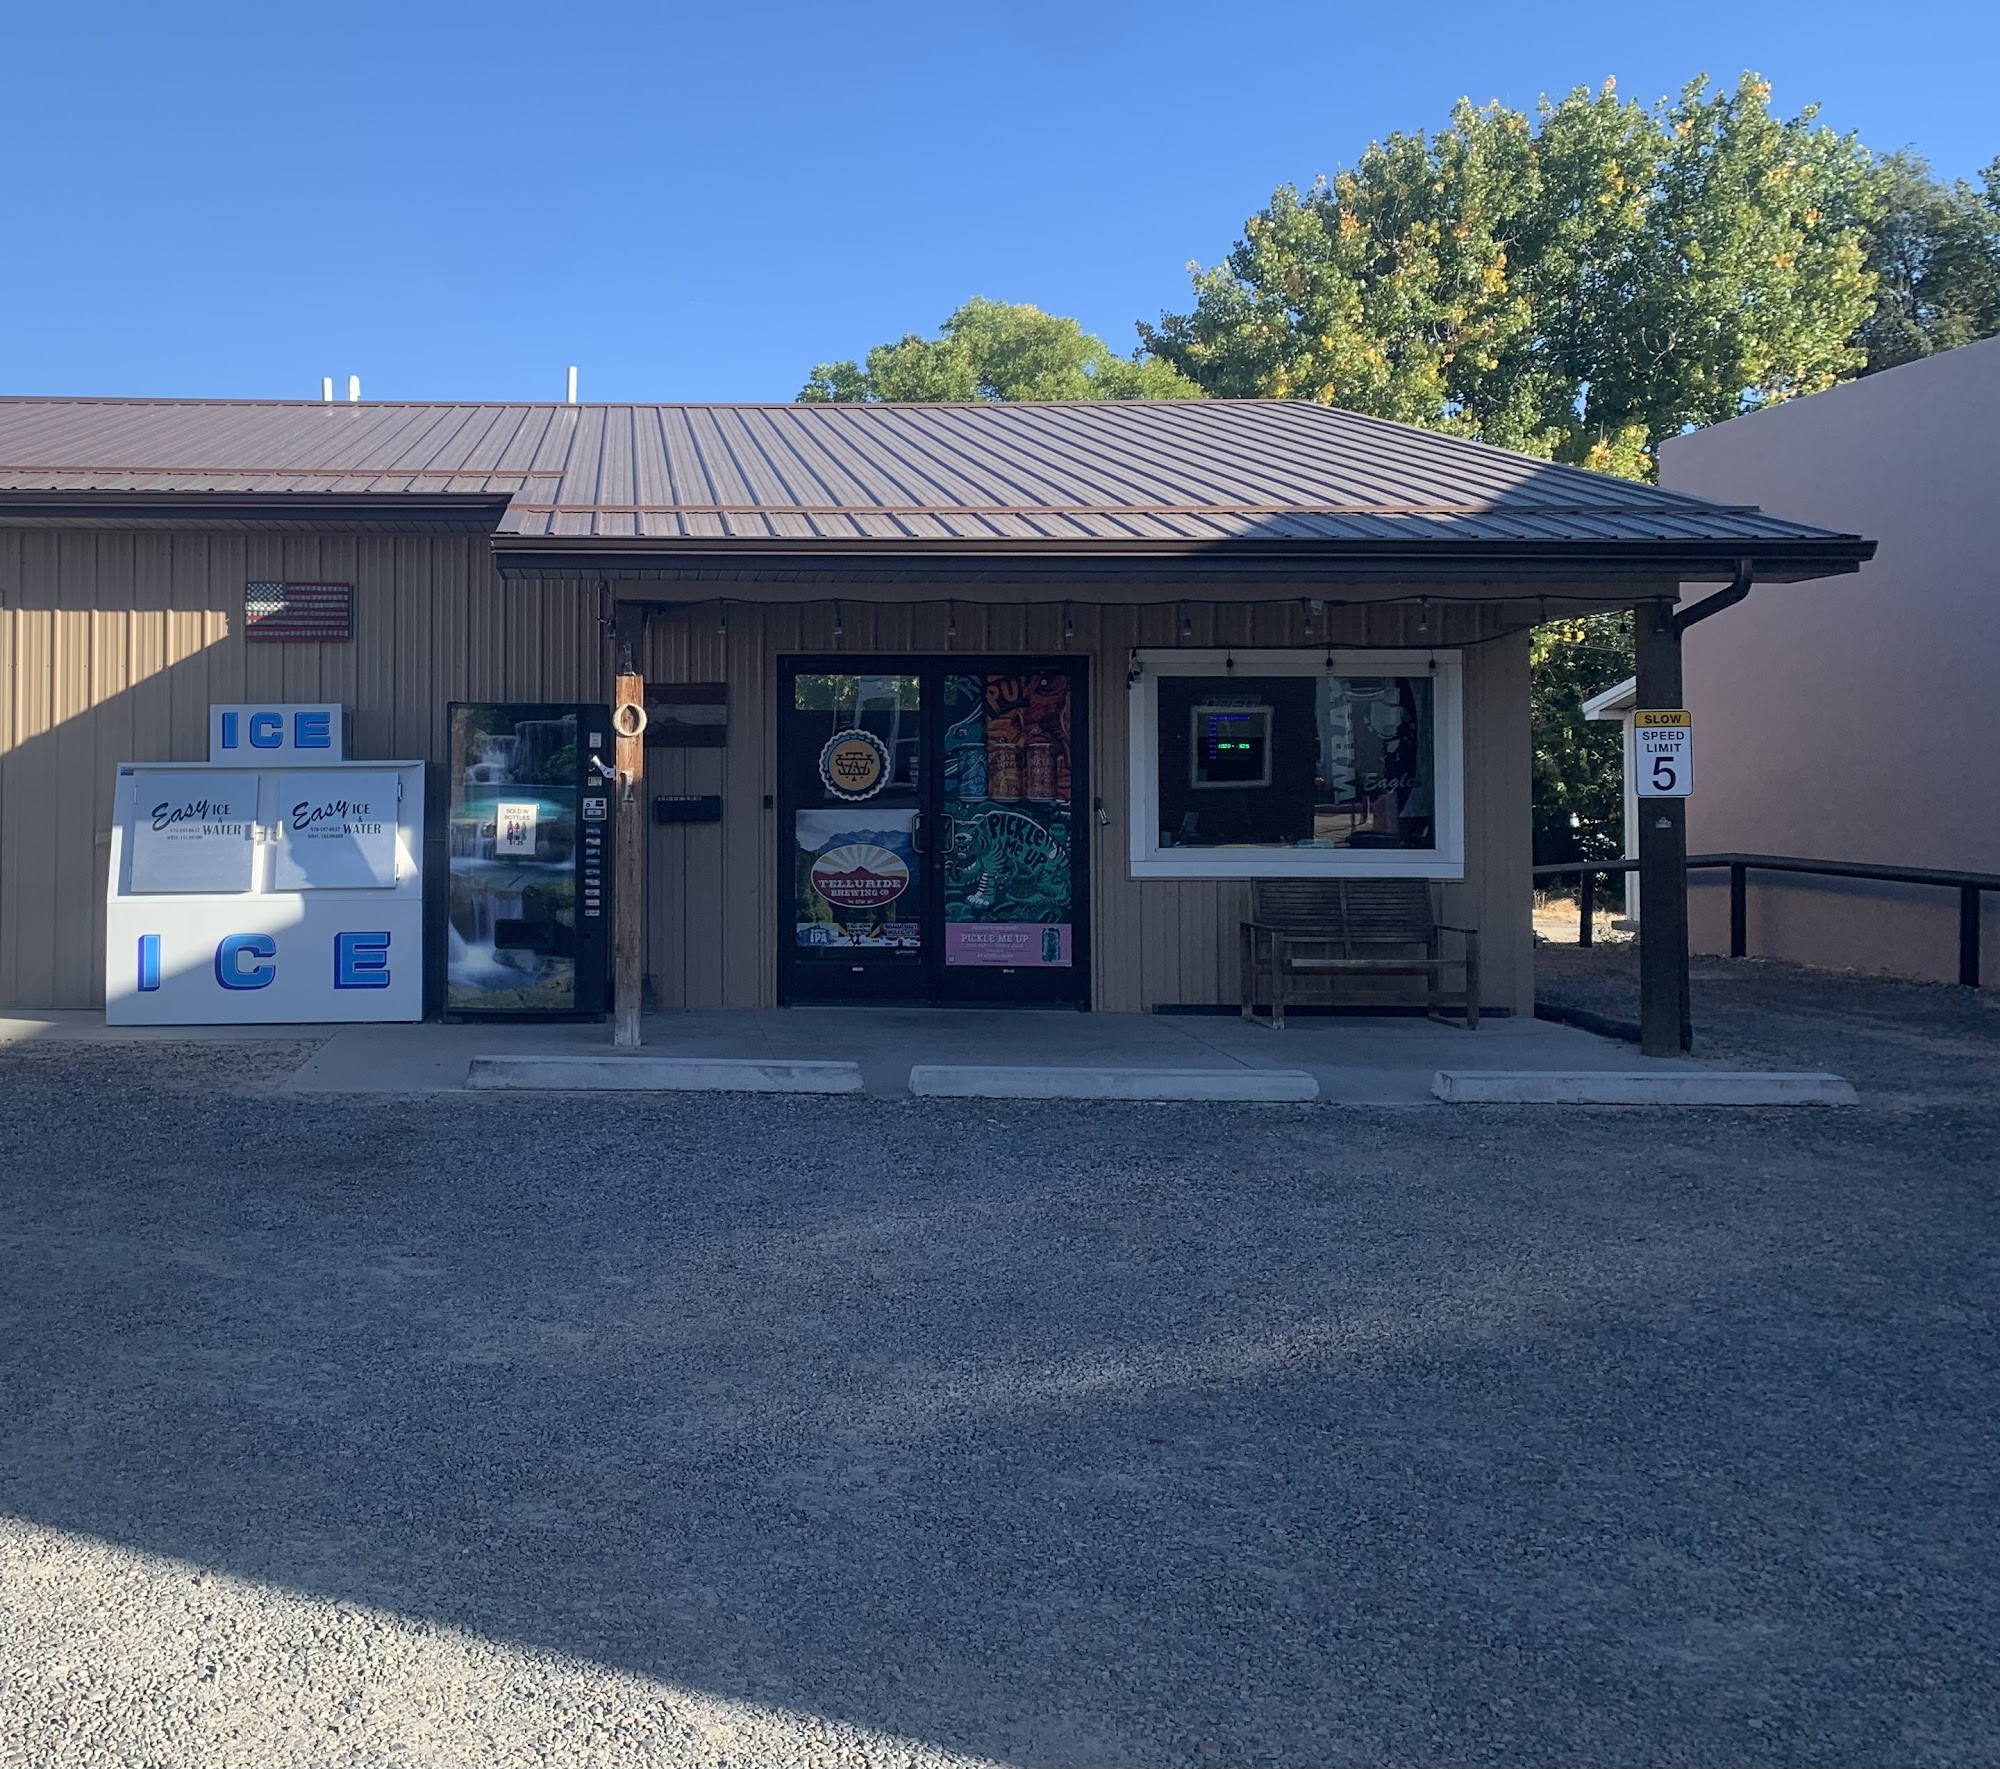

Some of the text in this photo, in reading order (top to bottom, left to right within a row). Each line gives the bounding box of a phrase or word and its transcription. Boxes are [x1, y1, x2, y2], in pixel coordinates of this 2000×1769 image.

[1644, 714, 1682, 724] SLOW
[222, 712, 331, 749] ICE
[1642, 731, 1685, 741] SPEED
[1646, 743, 1682, 753] LIMIT
[1652, 756, 1677, 791] 5
[151, 799, 231, 832] Easy ICE
[217, 816, 223, 824] &
[292, 799, 371, 831] Easy ICE
[358, 815, 363, 823] &
[203, 824, 241, 836] WATER
[343, 823, 381, 834] WATER
[1023, 847, 1048, 871] UP
[818, 879, 902, 889] TELLURIDE
[830, 889, 878, 897] BREWING
[810, 929, 827, 943] IPA
[961, 934, 1029, 943] PICKLE ME UP
[138, 931, 391, 993] ICE
